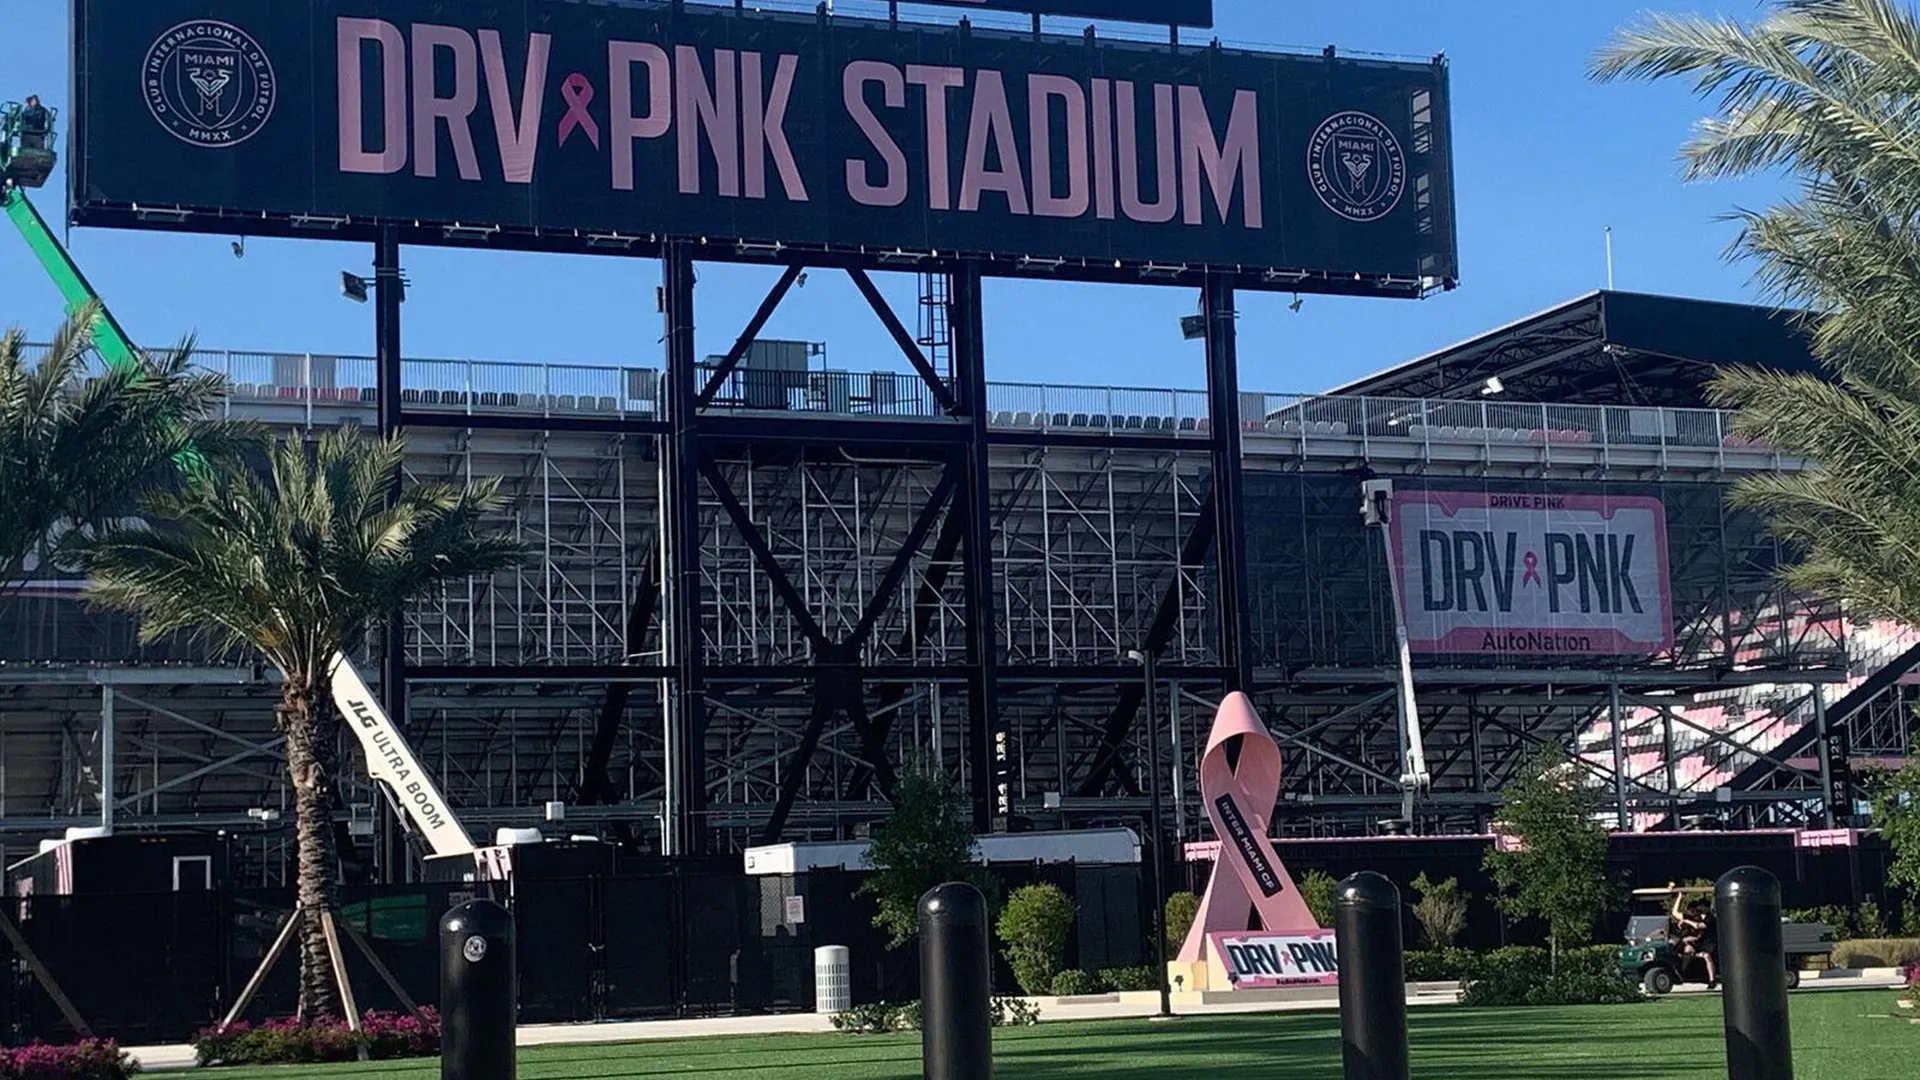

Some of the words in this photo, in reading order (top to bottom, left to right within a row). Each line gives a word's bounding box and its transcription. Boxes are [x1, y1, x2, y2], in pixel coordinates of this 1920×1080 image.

[149, 26, 248, 73] INTERNACIONAL
[184, 53, 235, 66] MIAMI
[249, 52, 265, 68] DE
[148, 79, 167, 113] CLUB
[188, 128, 231, 141] MMXX
[336, 16, 552, 184] DRV
[607, 40, 809, 201] PNK
[842, 60, 1263, 229] STADIUM
[1312, 116, 1384, 158] INTERNACIONAL
[1338, 140, 1375, 152] MIAMI
[1385, 139, 1396, 153] DE
[1311, 163, 1328, 192] CLUB
[1344, 205, 1375, 216] MMXX
[1490, 495, 1532, 508] DRIVE
[1533, 496, 1565, 509] PINK
[1419, 529, 1518, 613] DRV
[1544, 532, 1644, 614] PNK
[1481, 631, 1590, 651] AutoNation
[347, 699, 379, 729] JLG
[372, 731, 411, 781] ULTRA
[405, 781, 446, 830] BOOM
[1221, 801, 1245, 836] INTER
[1240, 837, 1266, 872] MIAMI
[1226, 943, 1283, 975] DRV
